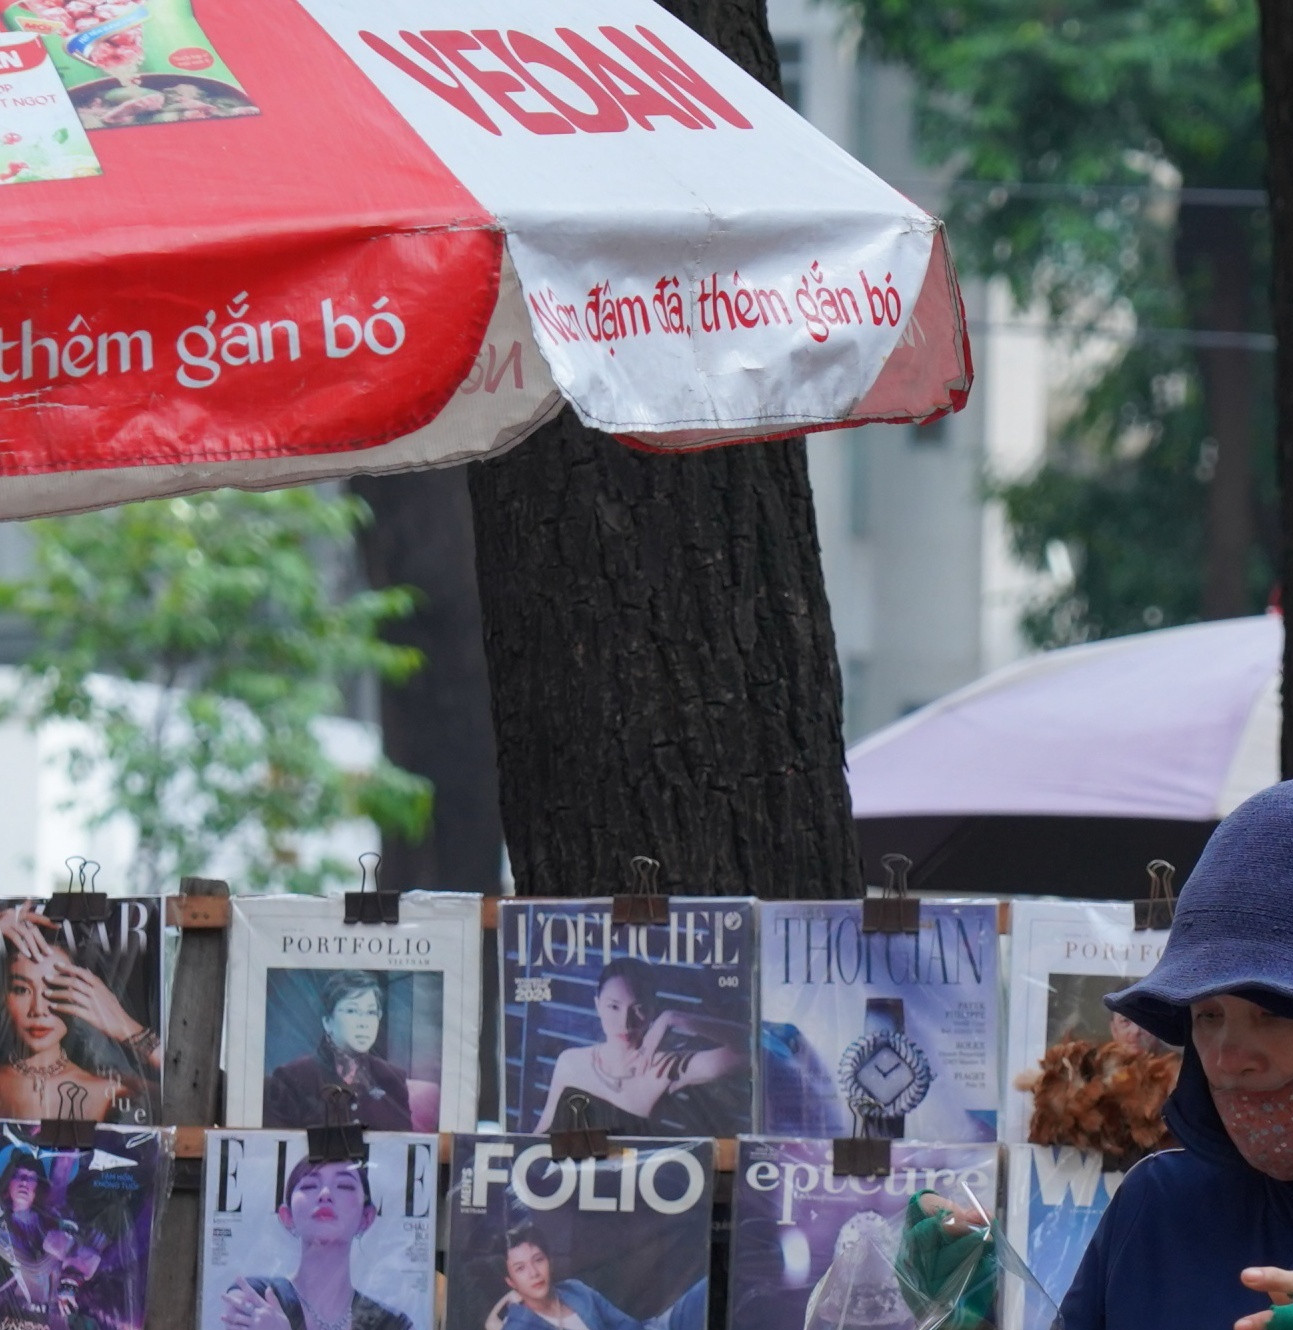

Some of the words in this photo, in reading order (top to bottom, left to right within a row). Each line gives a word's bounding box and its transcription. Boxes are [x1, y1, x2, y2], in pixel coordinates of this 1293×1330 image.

[359, 25, 754, 136] VEDAN
[0, 313, 154, 383] thêm
[176, 290, 301, 388] gắn
[320, 296, 406, 359] bó
[585, 279, 651, 357] đậm
[699, 270, 791, 332] thêm
[796, 260, 863, 343] gắn
[859, 270, 902, 328] bó
[282, 935, 431, 955] PORTFOLIO
[1065, 941, 1164, 962] PORTF
[214, 1138, 432, 1219] ELE
[472, 1142, 705, 1215] FOLIO
[745, 1150, 990, 1227] epicure
